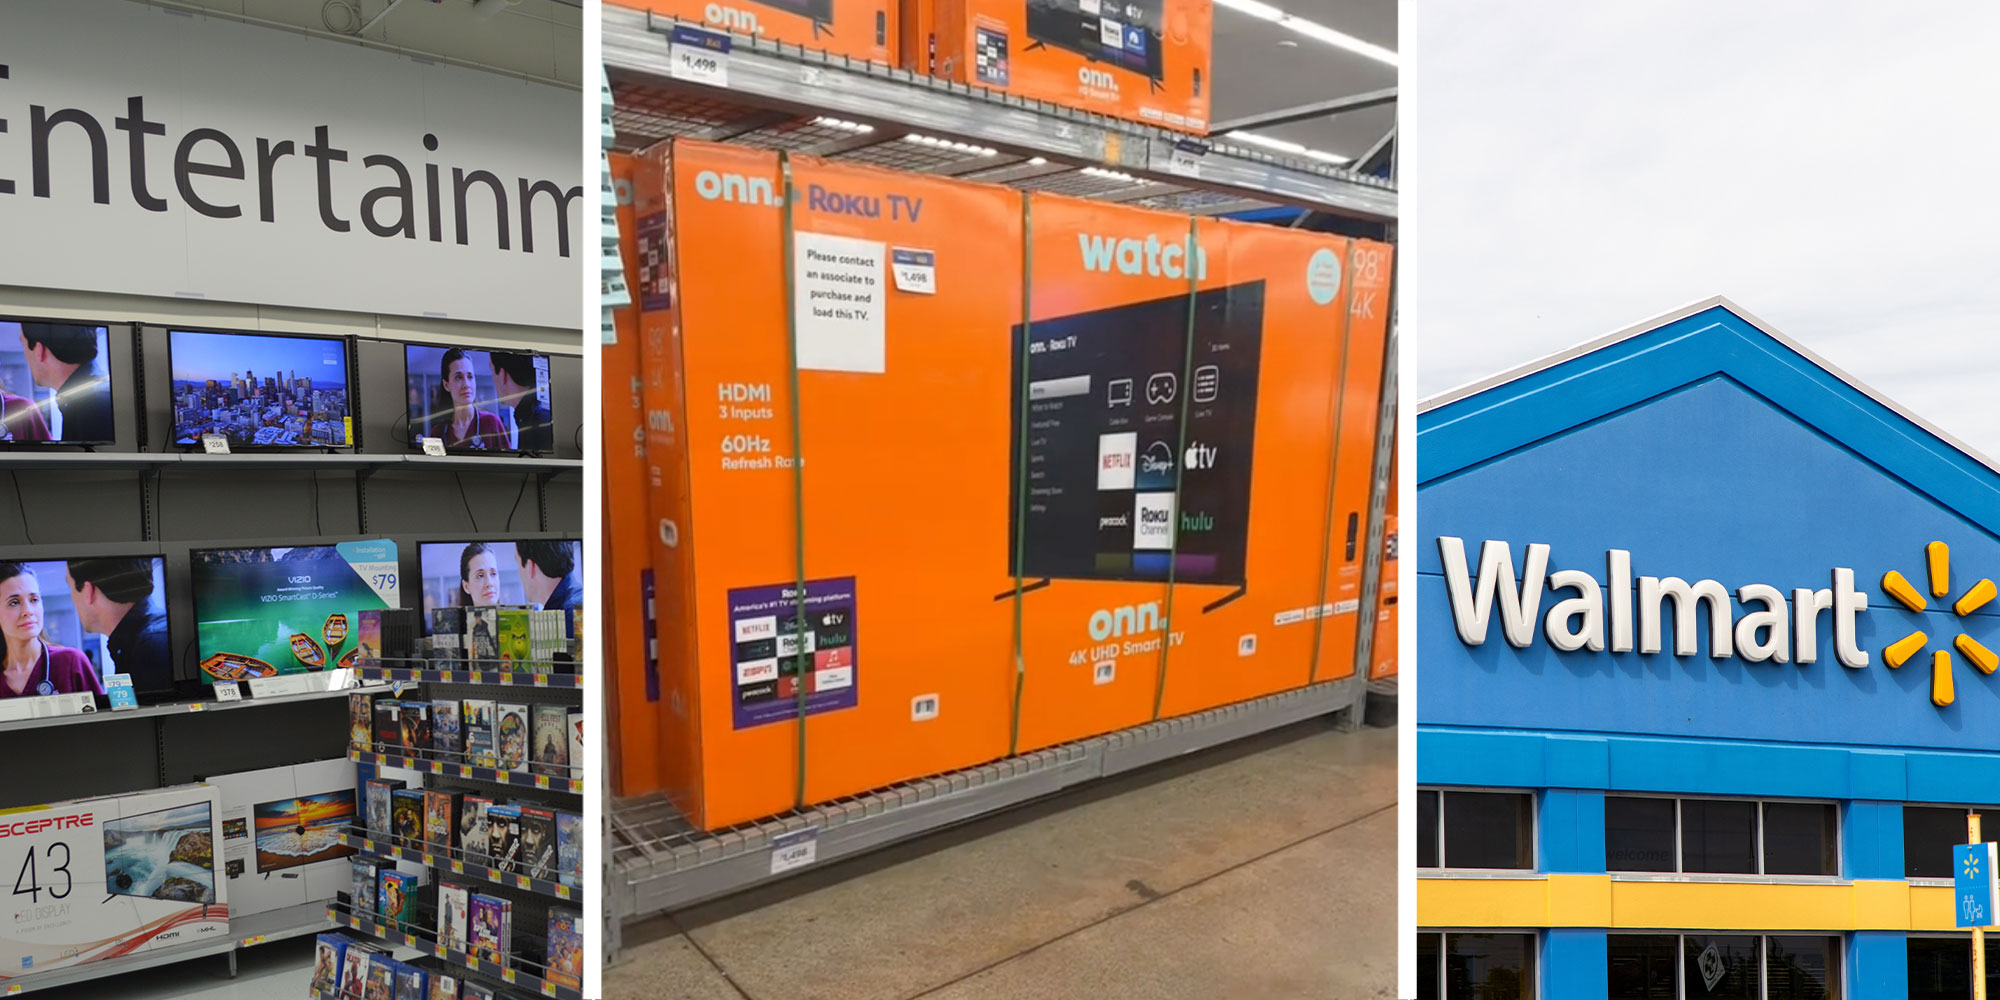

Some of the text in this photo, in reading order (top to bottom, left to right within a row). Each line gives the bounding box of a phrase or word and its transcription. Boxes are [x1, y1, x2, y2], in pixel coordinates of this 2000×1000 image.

[704, 2, 765, 34] onn.
[1078, 66, 1119, 92] onn.
[0, 64, 583, 258] ntertainm
[695, 170, 784, 208] onn.
[886, 193, 923, 223] TV
[807, 248, 875, 267] Please contact
[1078, 233, 1207, 280] watch
[806, 271, 875, 285] an associate to
[810, 289, 872, 303] purchase and
[812, 306, 833, 318] load
[835, 309, 853, 320] this
[718, 383, 771, 403] HDMI
[719, 406, 774, 422] 3 Inputs
[721, 435, 771, 453] 60Hz
[722, 456, 772, 471] Refresh
[1199, 443, 1218, 470] tv
[1181, 510, 1214, 531] hulu
[287, 575, 312, 584] VIZIO
[372, 573, 397, 590] $79
[260, 594, 278, 602] VIZIO
[1437, 535, 1870, 669] Walmart
[1088, 602, 1168, 642] onn.
[820, 633, 847, 646] hulu
[1069, 631, 1185, 666] 4K UHD Smart TV
[0, 813, 94, 838] SCEPTRE
[12, 841, 73, 904] 43
[156, 931, 180, 941] HDMI
